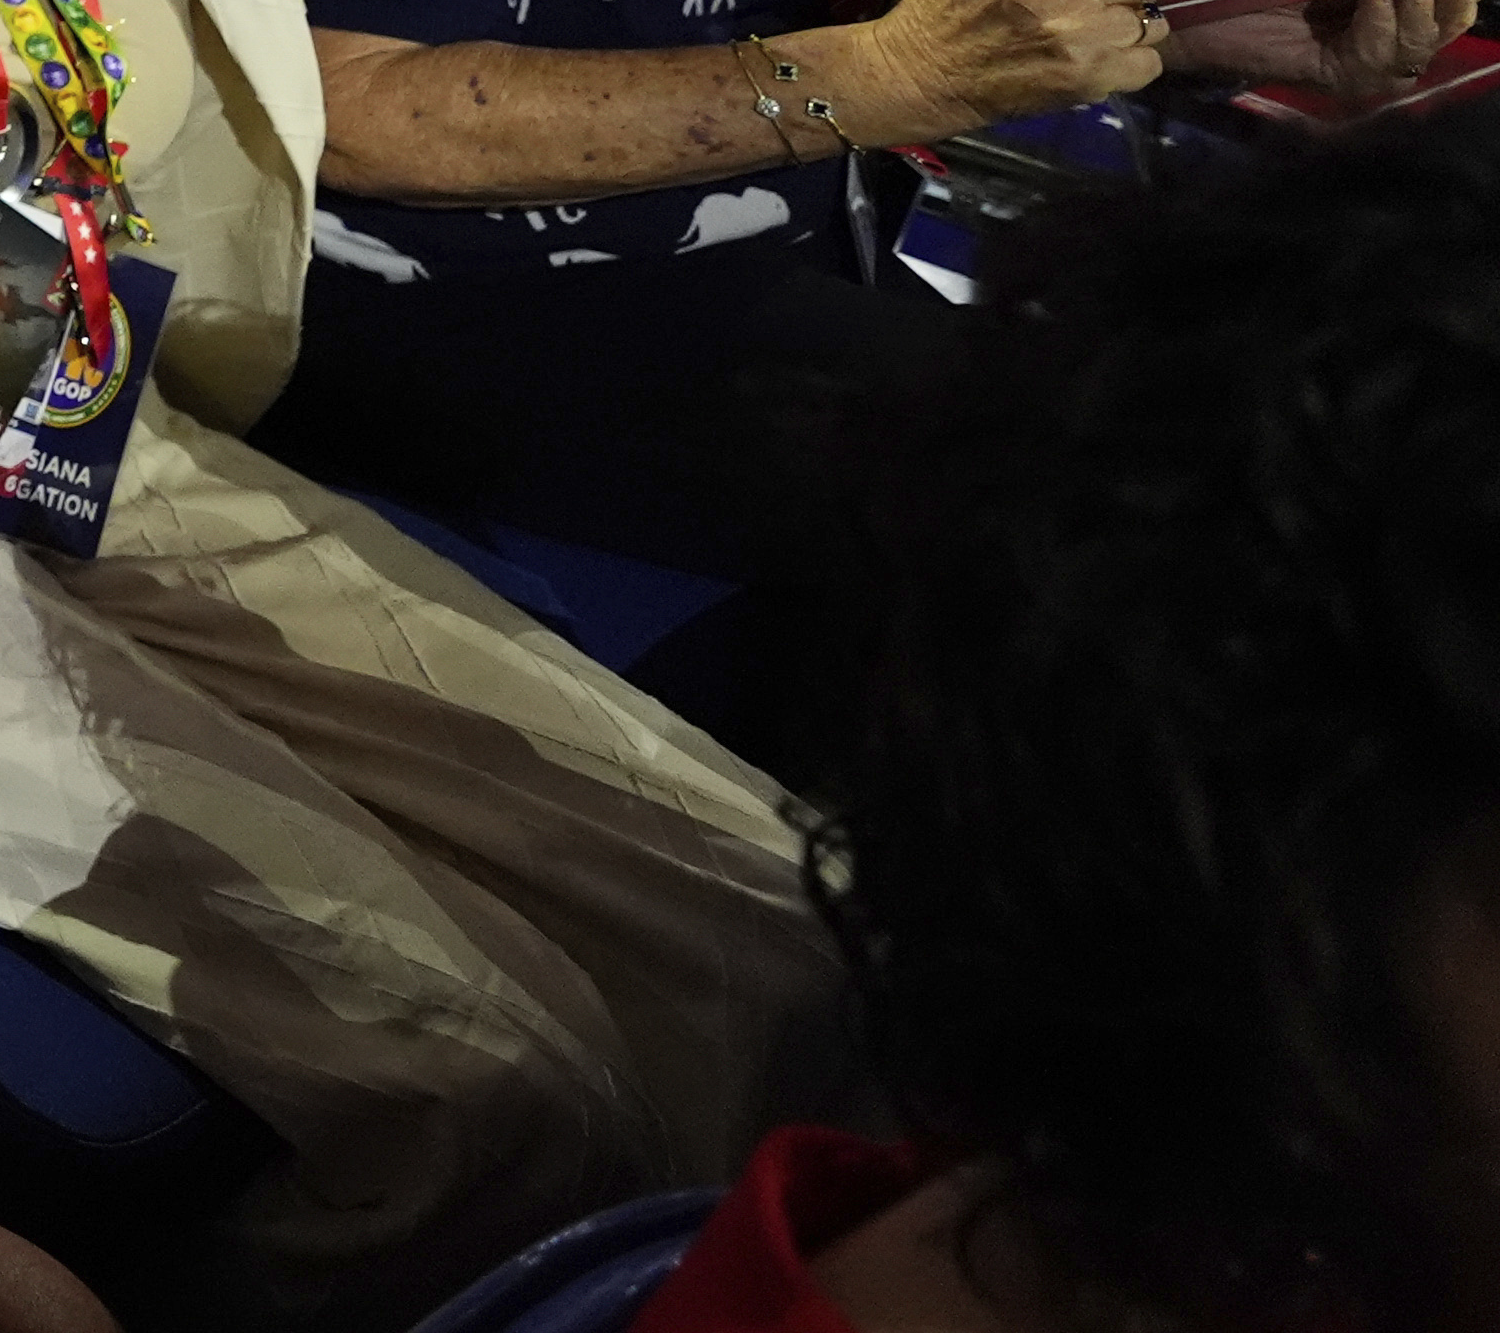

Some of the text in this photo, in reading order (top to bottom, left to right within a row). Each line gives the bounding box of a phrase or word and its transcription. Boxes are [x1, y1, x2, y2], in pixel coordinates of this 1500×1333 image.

[53, 378, 93, 403] GOP
[25, 448, 92, 489] SIANA
[15, 476, 99, 523] GATION
